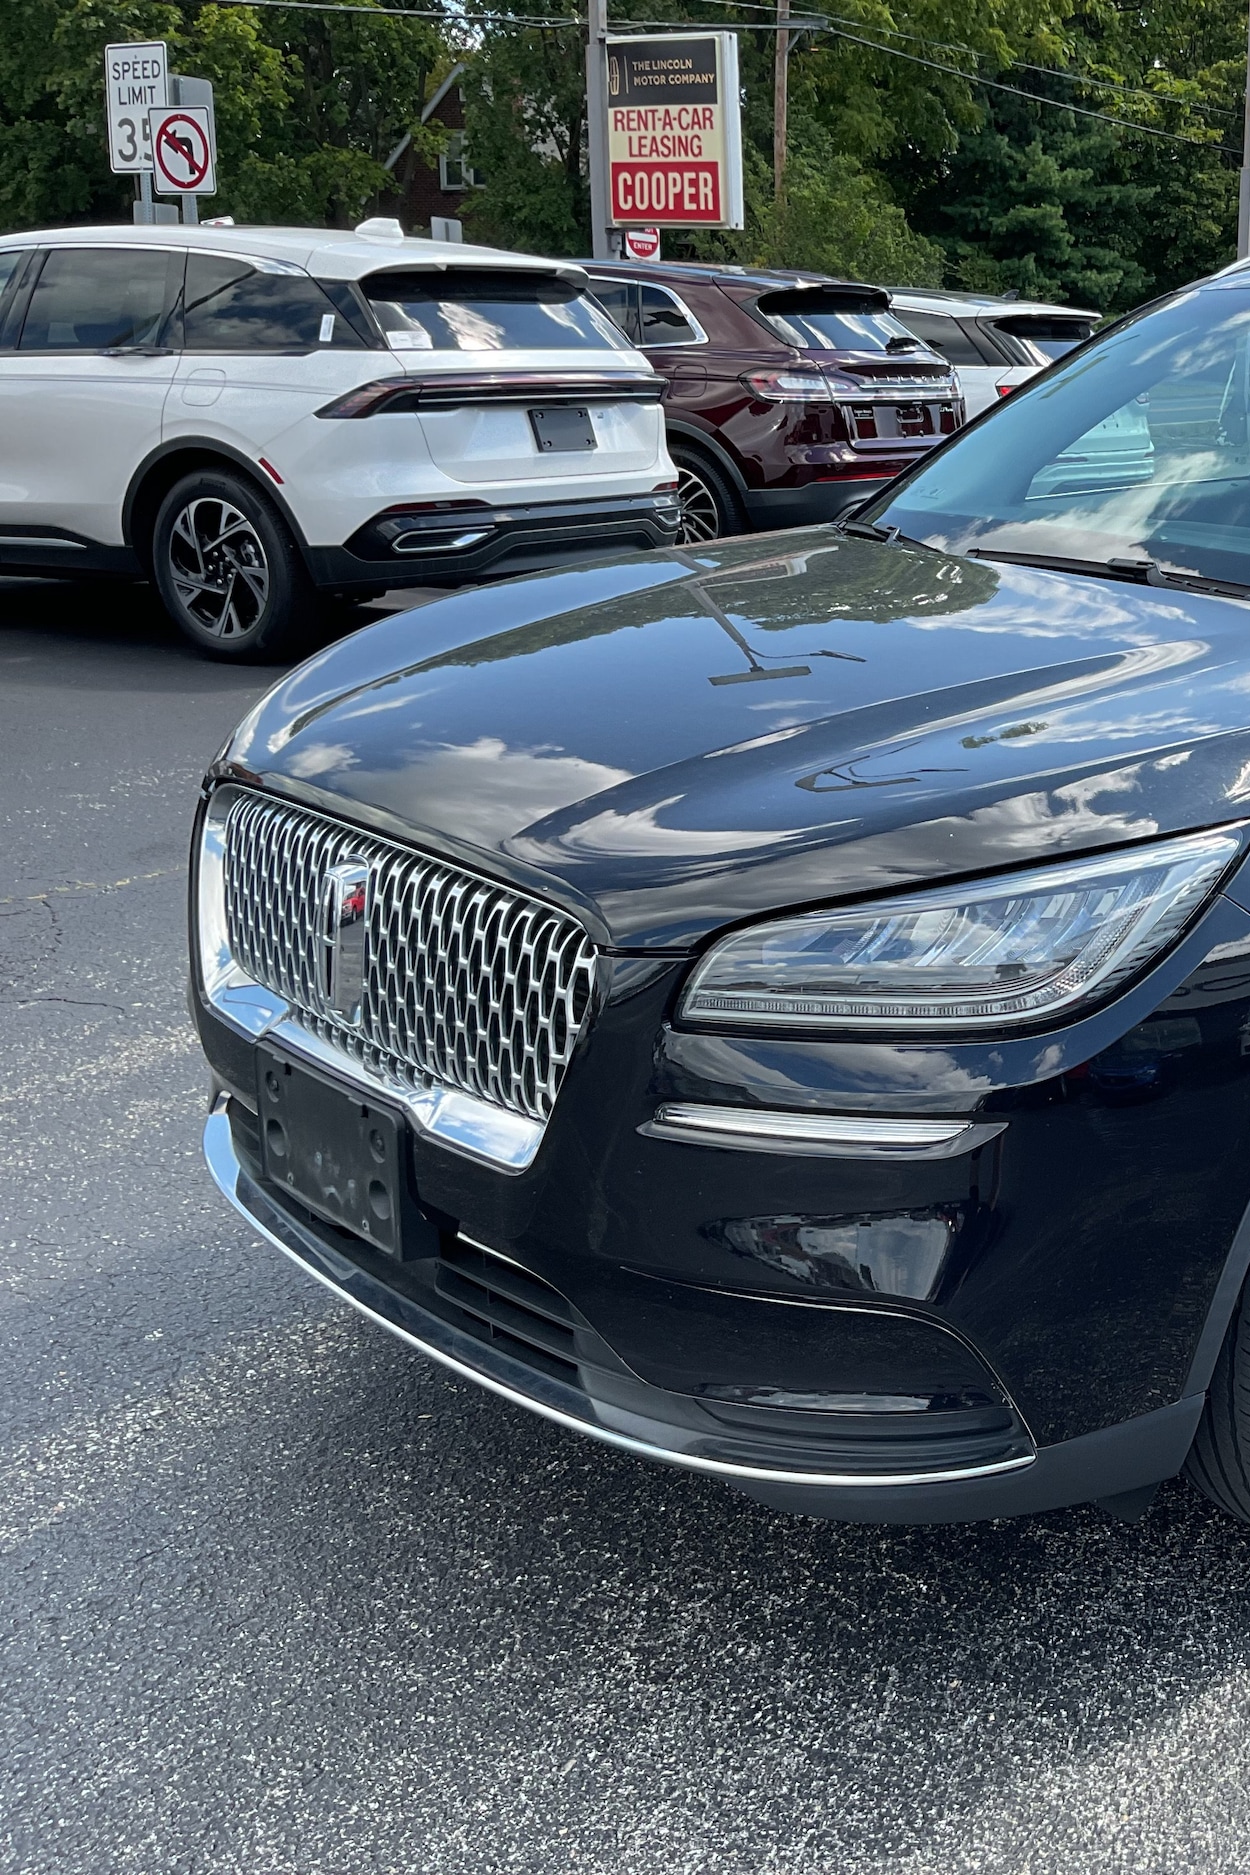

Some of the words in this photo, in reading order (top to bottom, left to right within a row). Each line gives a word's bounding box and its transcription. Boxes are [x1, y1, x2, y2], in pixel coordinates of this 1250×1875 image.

[112, 60, 161, 81] SPEED
[632, 61, 650, 70] THE
[652, 59, 693, 70] LINCOLN
[633, 75, 666, 86] MOTOR
[669, 73, 715, 85] COMPANY
[118, 86, 156, 105] LIMIT
[613, 107, 714, 132] RENT-A-CAR
[628, 134, 703, 158] LEASING
[617, 171, 714, 211] COOPER
[633, 241, 653, 251] ENTER
